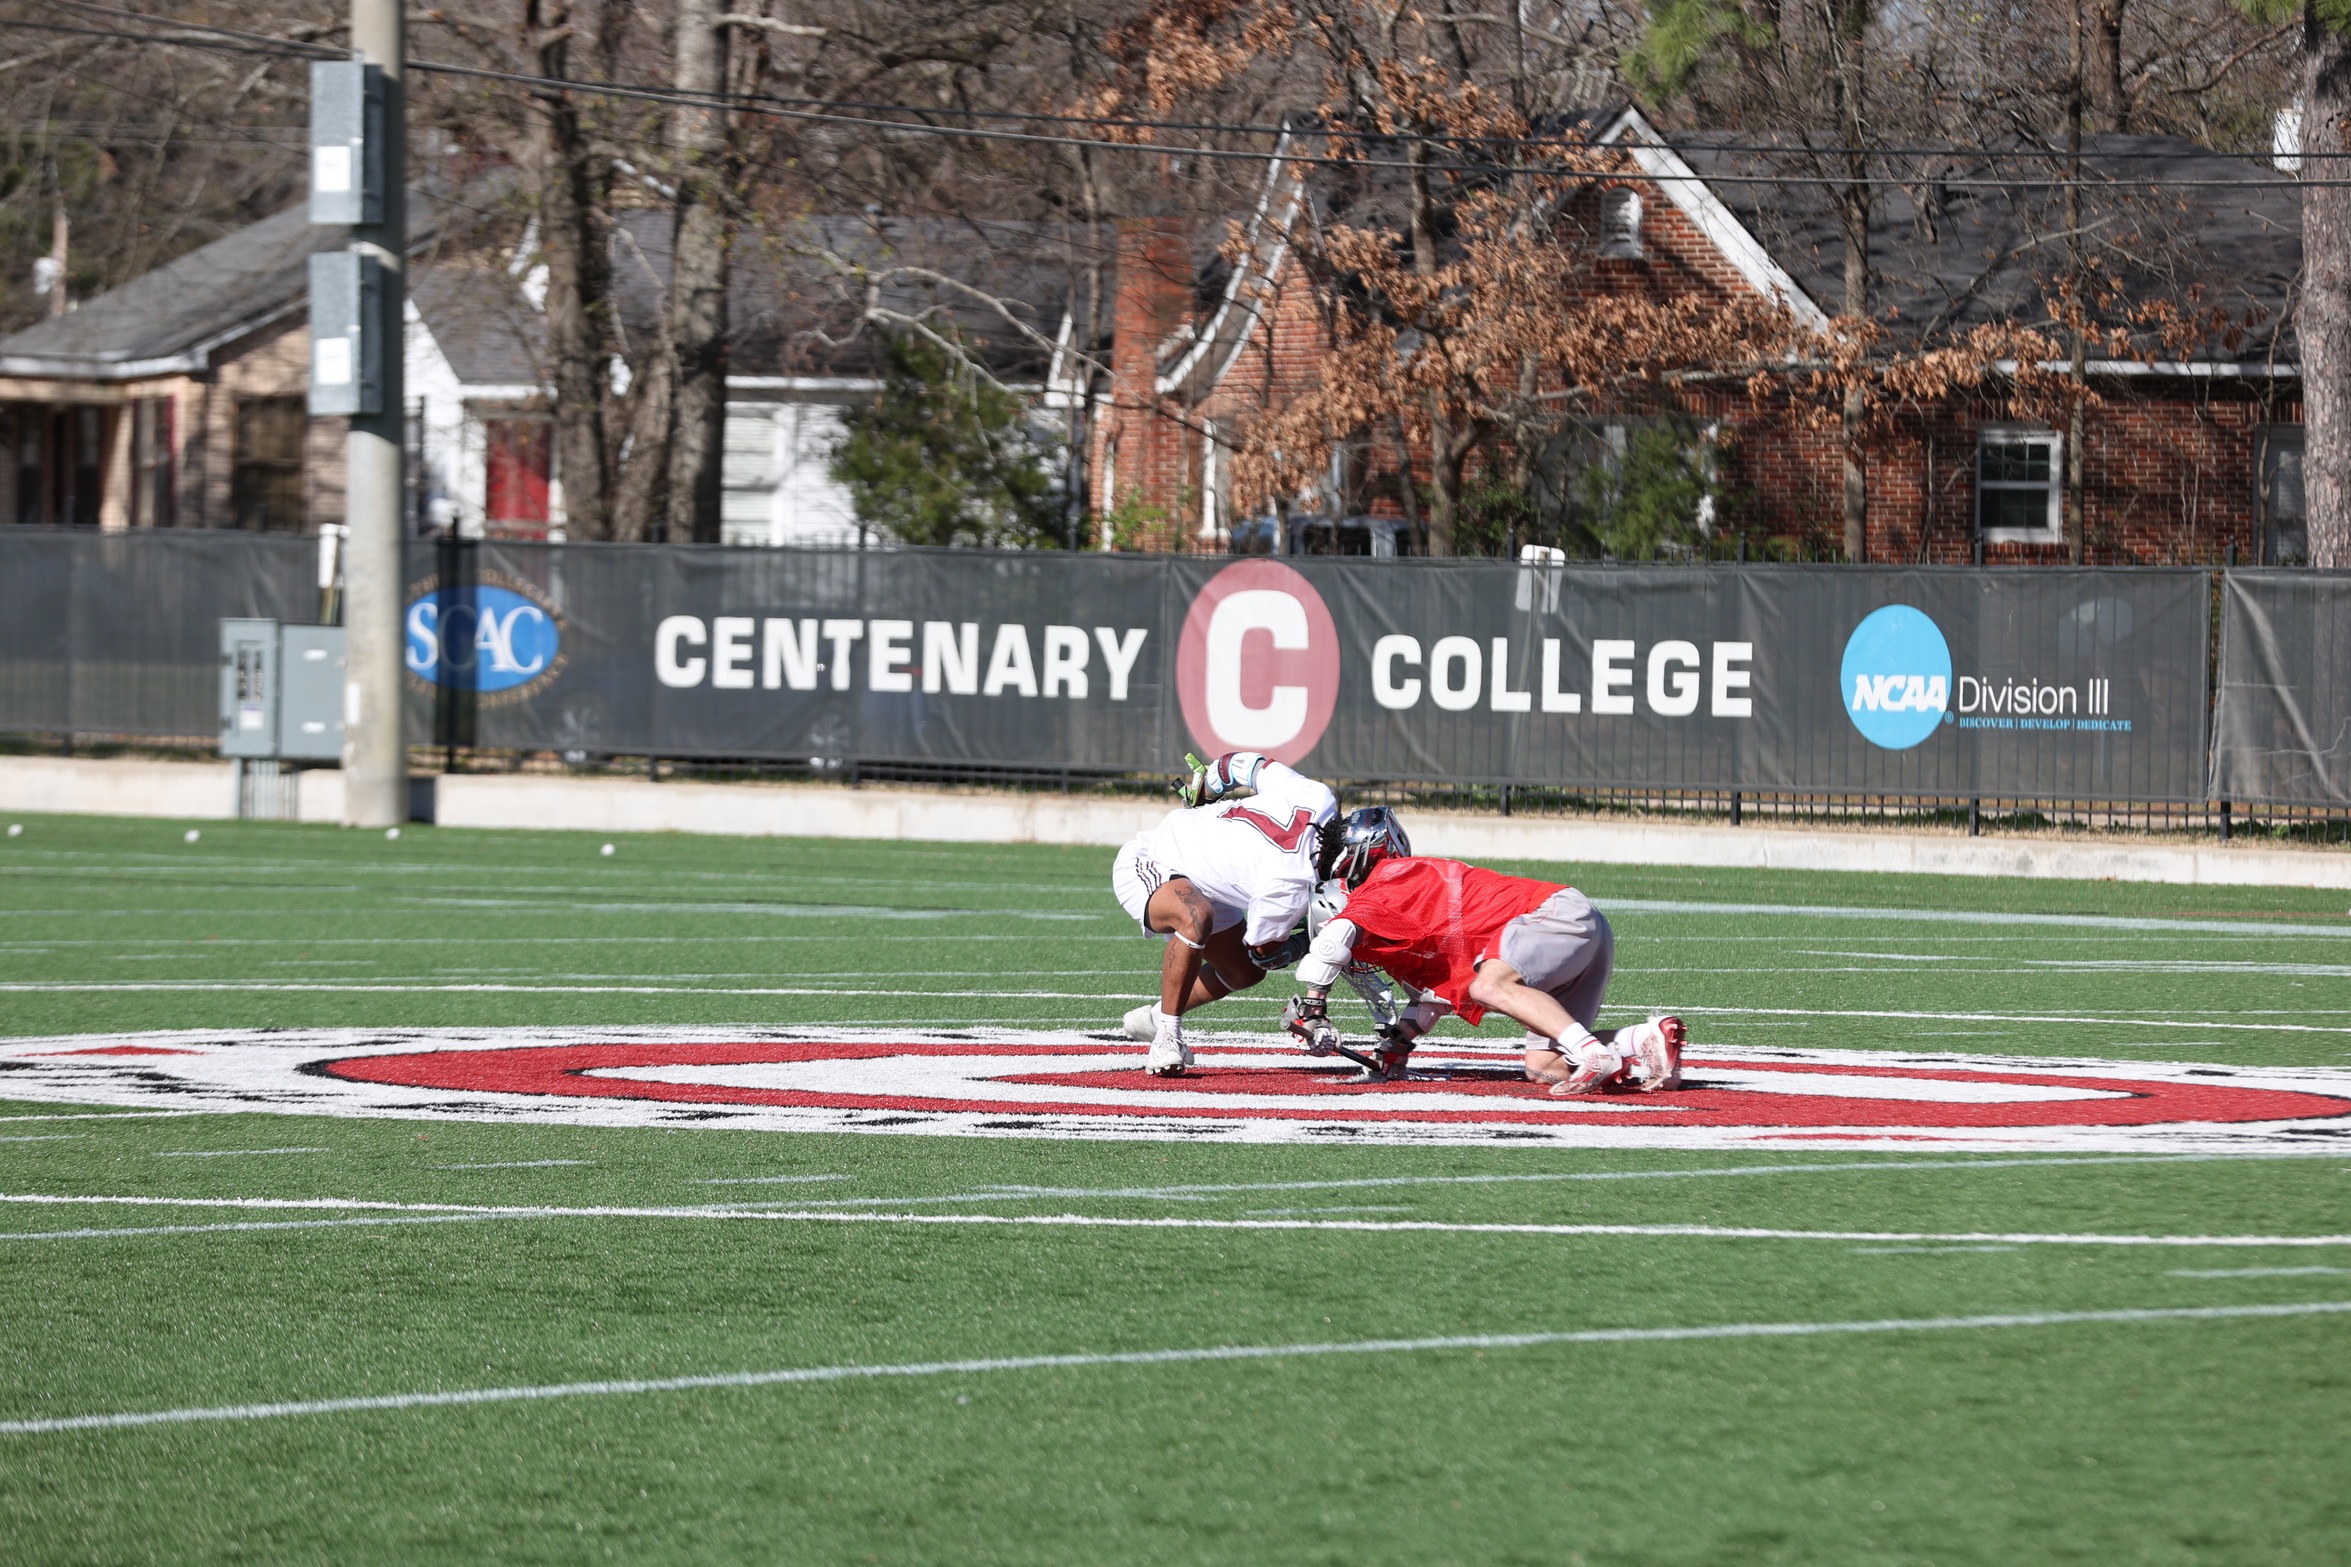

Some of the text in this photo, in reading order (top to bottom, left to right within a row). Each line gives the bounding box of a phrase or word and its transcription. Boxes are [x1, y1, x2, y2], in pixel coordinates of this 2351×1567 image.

[655, 615, 1149, 700] CENTENARY
[1206, 589, 1309, 749] C
[1371, 634, 1753, 718] COLLEGE
[1852, 674, 1947, 712] NCAA
[1958, 676, 2109, 715] Division III
[1959, 717, 2132, 732] DISCOVER DEVELOP DEDICATE
